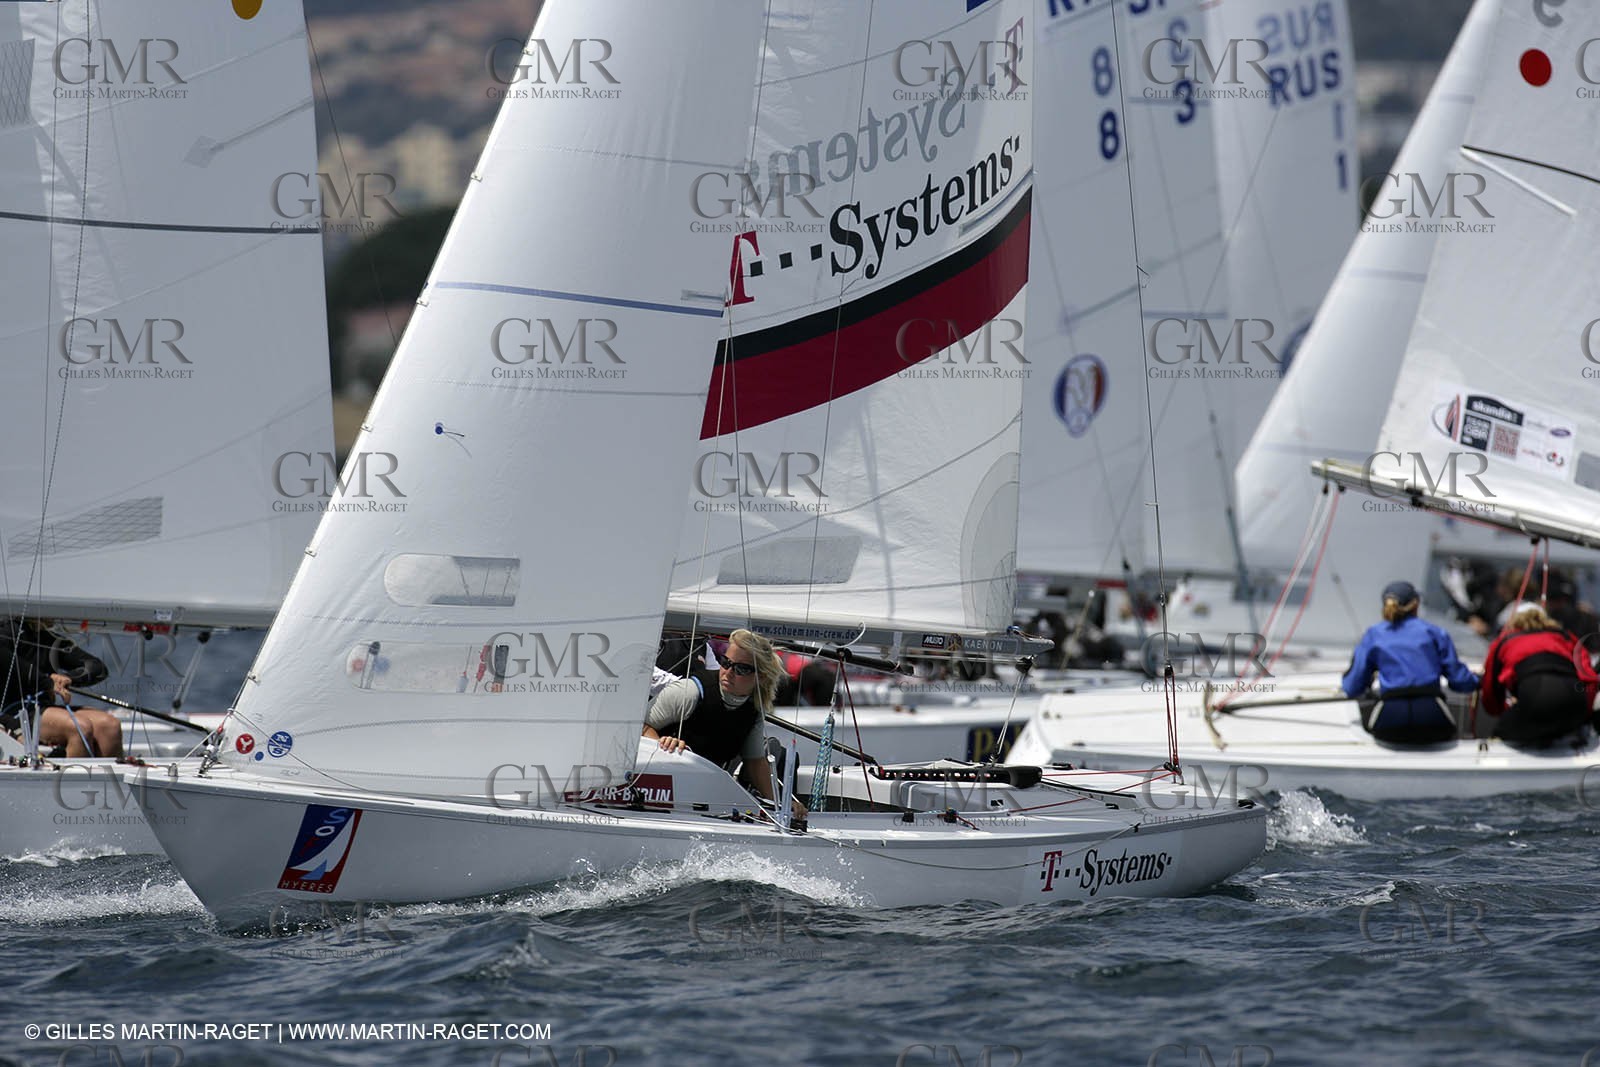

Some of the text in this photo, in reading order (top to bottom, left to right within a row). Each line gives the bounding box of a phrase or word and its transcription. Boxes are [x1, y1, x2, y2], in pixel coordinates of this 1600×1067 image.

[1174, 79, 1196, 124] 3
[1268, 50, 1342, 108] RUS
[1099, 110, 1119, 160] 8
[1334, 152, 1348, 191] 1
[963, 638, 1003, 651] KAENON
